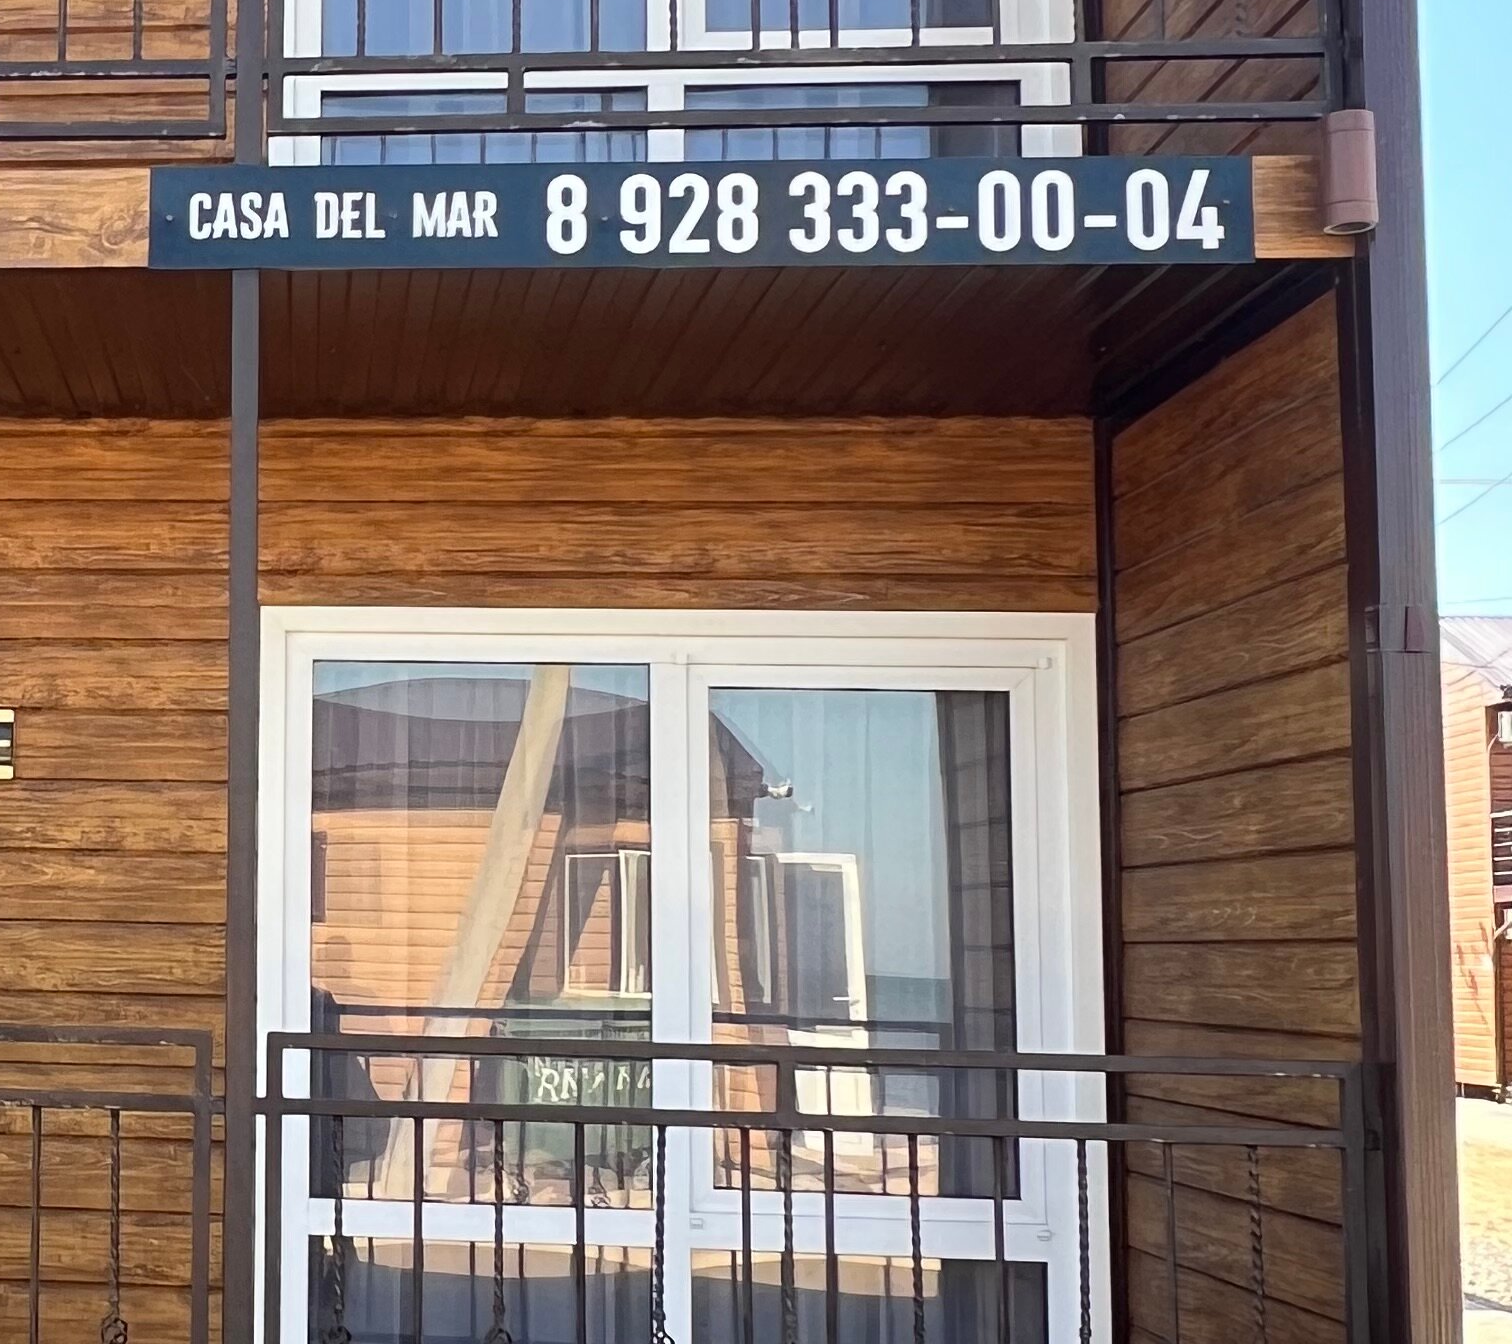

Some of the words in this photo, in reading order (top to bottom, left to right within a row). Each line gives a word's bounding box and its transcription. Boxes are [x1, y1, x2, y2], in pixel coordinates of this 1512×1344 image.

[188, 191, 289, 240] CASA
[314, 191, 386, 239] DEL
[412, 190, 499, 239] MAR
[546, 173, 588, 255] 8
[619, 172, 759, 255] 928
[788, 168, 1225, 254] 333-00-04
